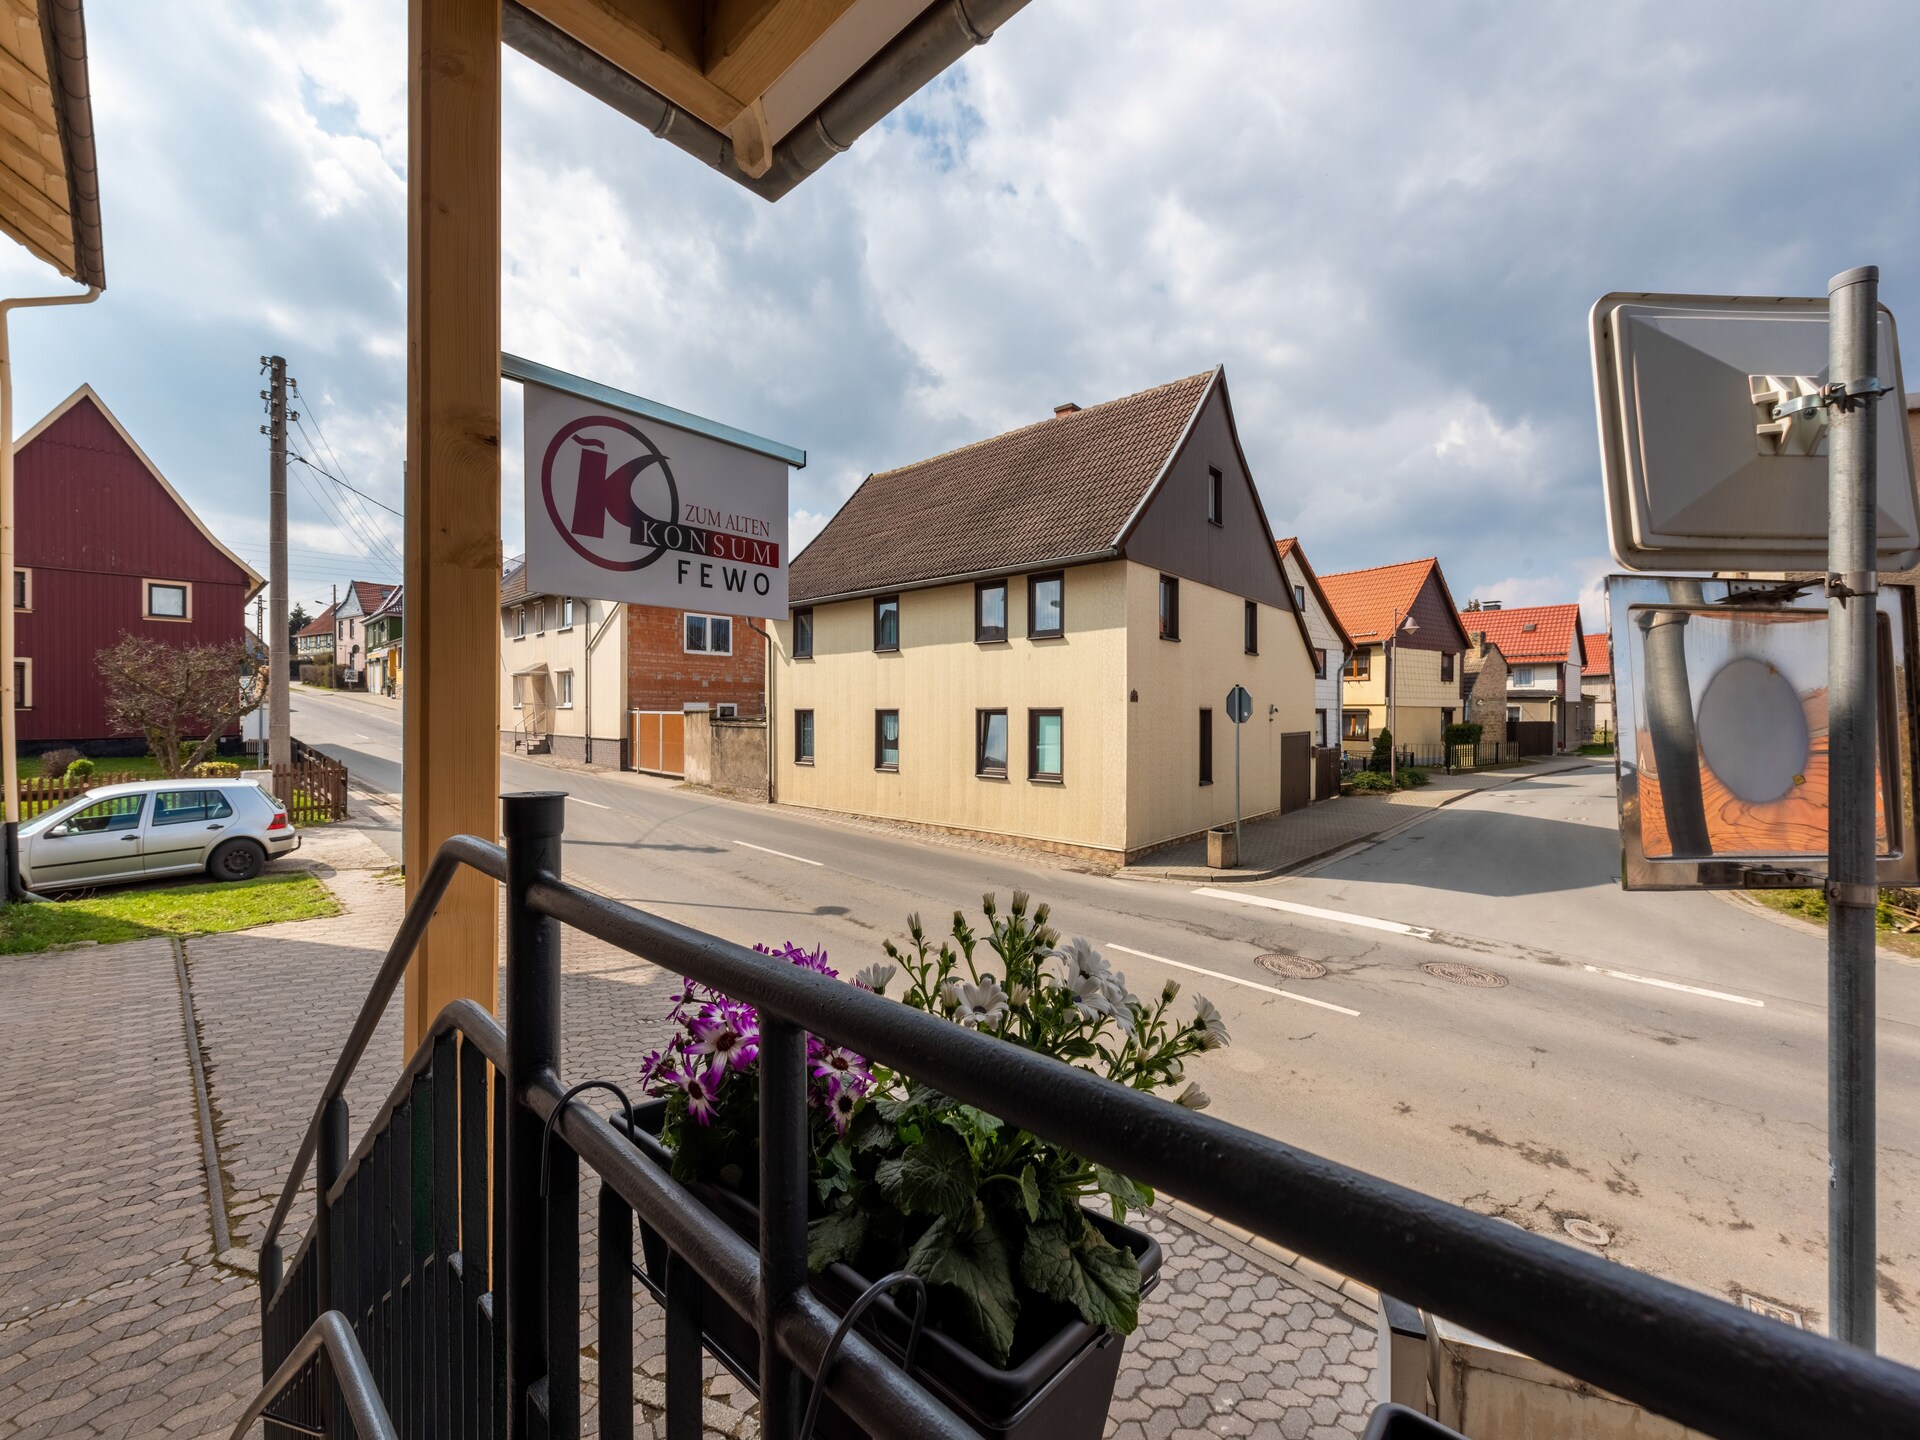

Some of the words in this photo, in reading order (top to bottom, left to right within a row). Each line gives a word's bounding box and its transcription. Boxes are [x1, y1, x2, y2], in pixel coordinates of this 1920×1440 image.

[685, 503, 722, 528] ZUM
[725, 513, 770, 538] ALTEN
[641, 519, 771, 566] KONSUM
[677, 558, 770, 596] FEWO
